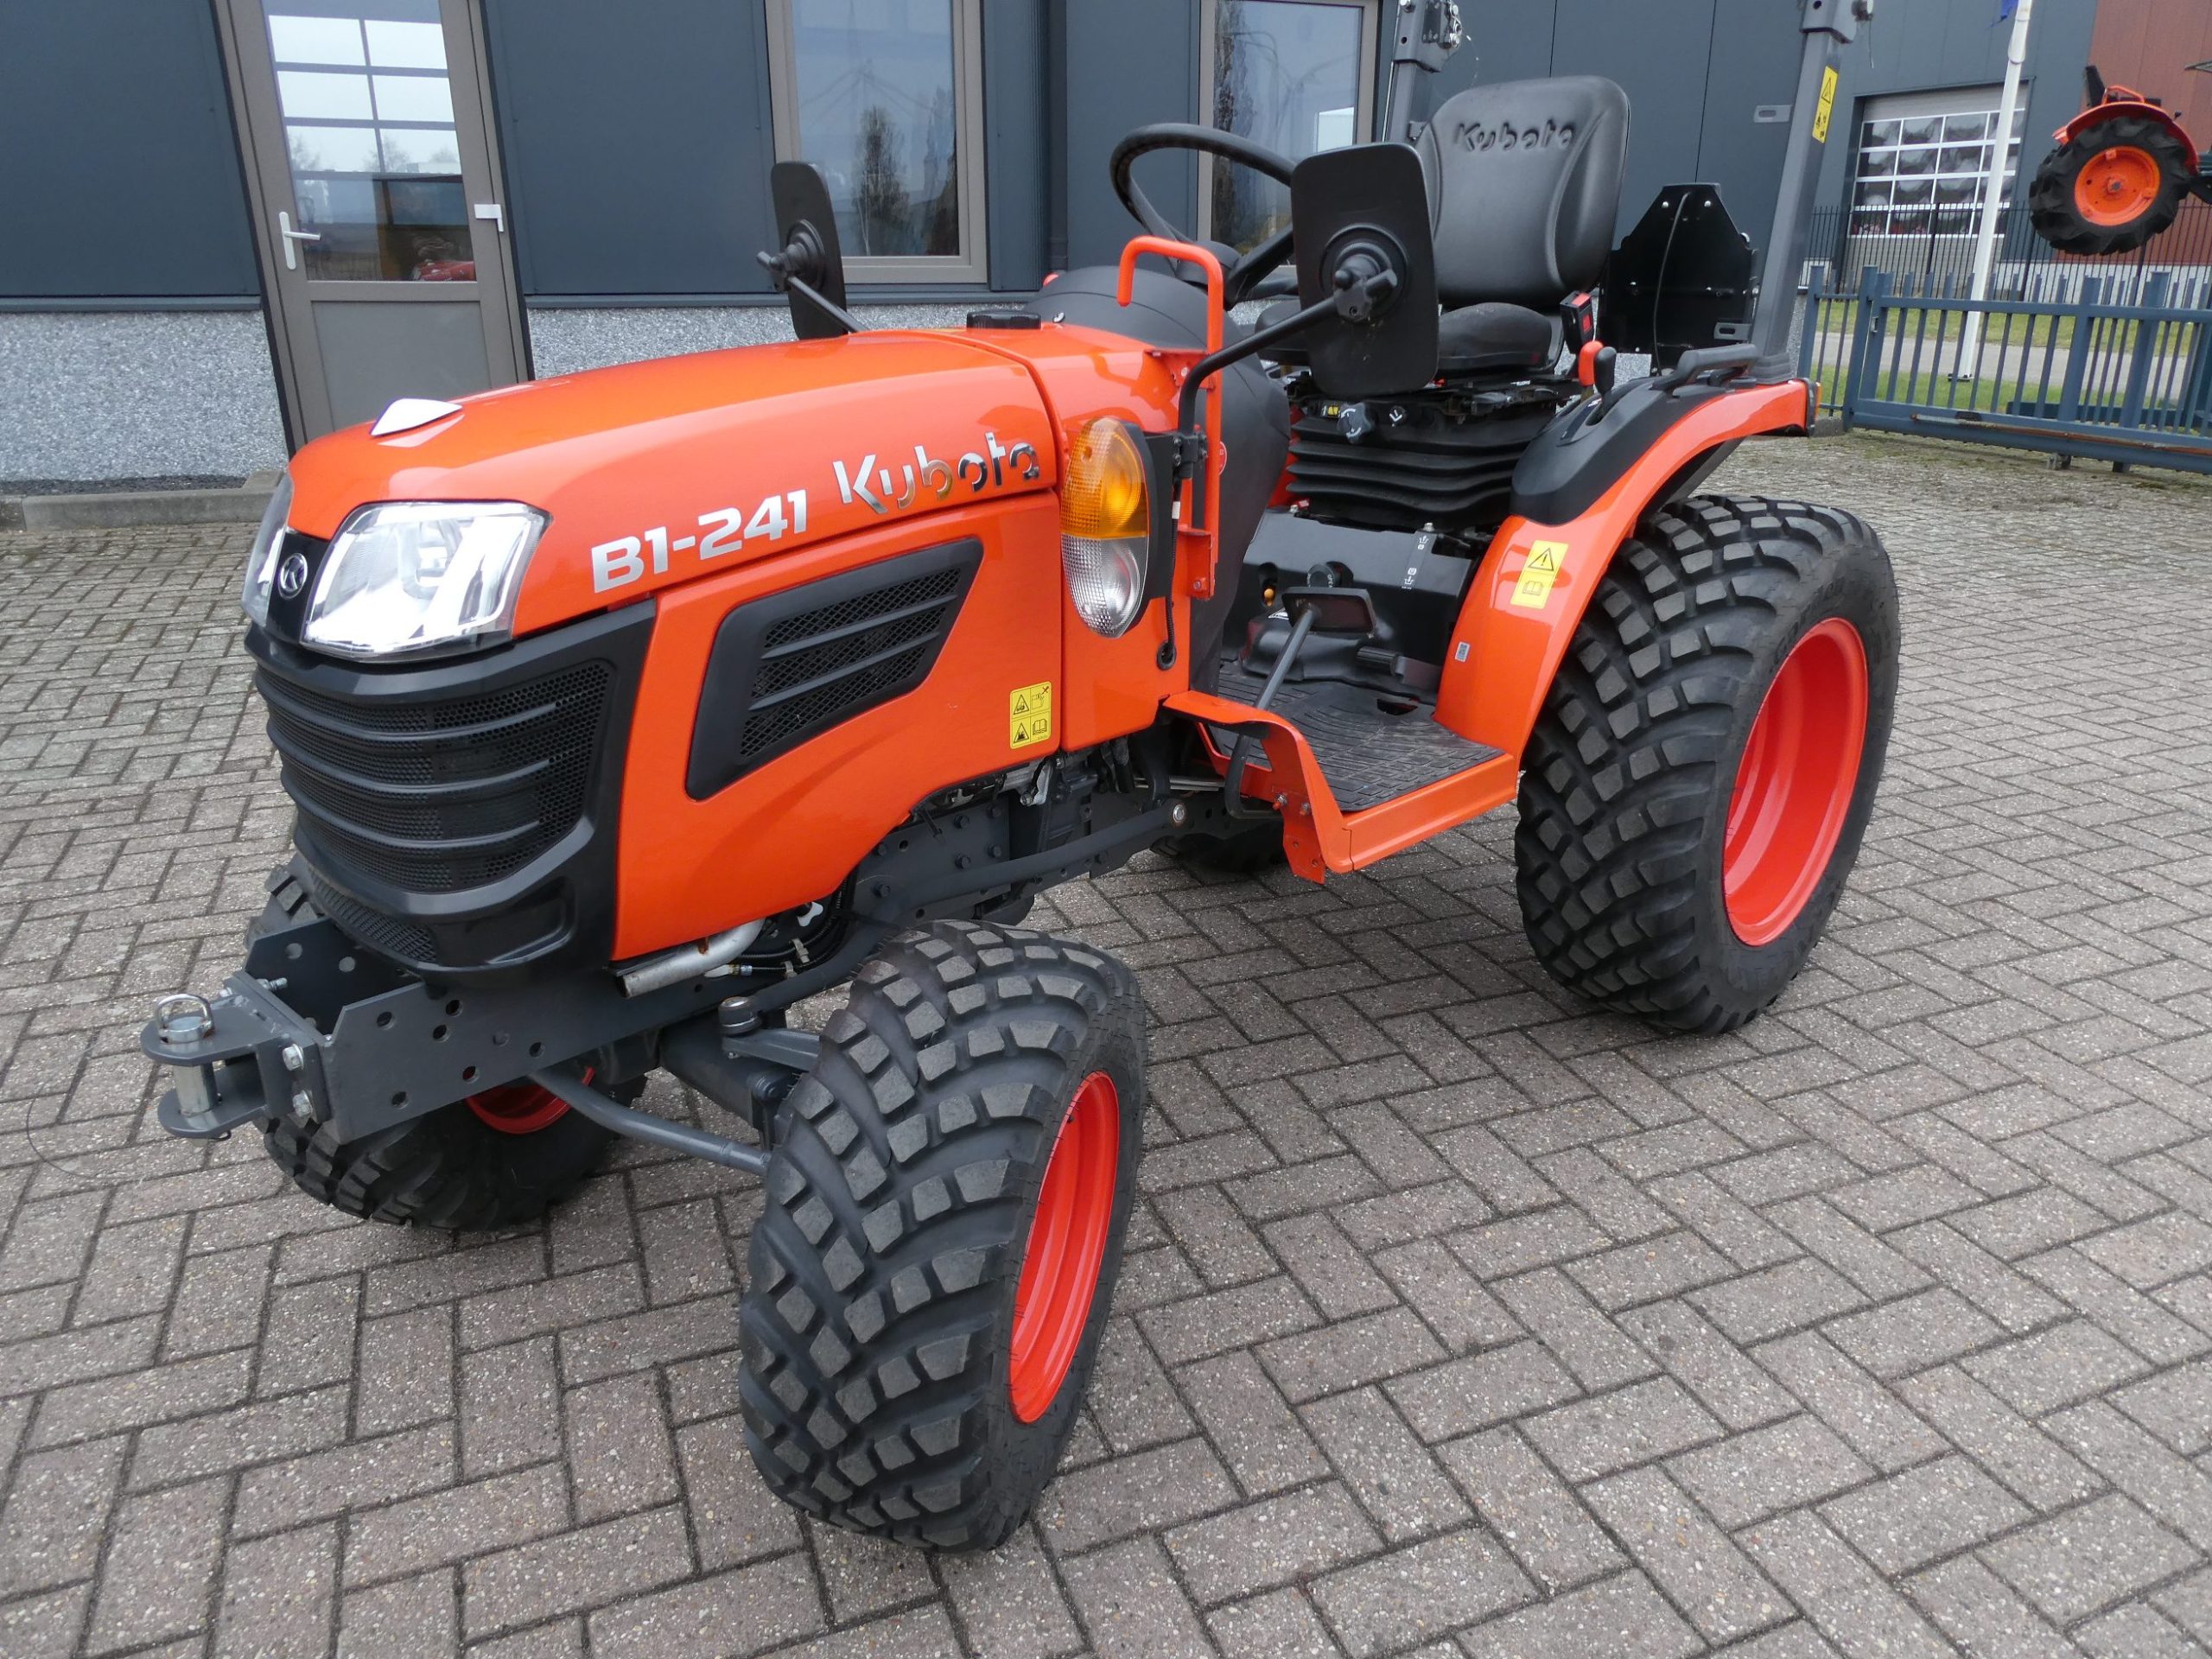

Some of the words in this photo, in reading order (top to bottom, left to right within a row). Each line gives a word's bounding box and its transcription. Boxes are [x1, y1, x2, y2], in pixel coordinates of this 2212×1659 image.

[1455, 118, 1575, 151] Kubota
[832, 432, 1039, 514] Kubota
[590, 489, 808, 594] B1-241
